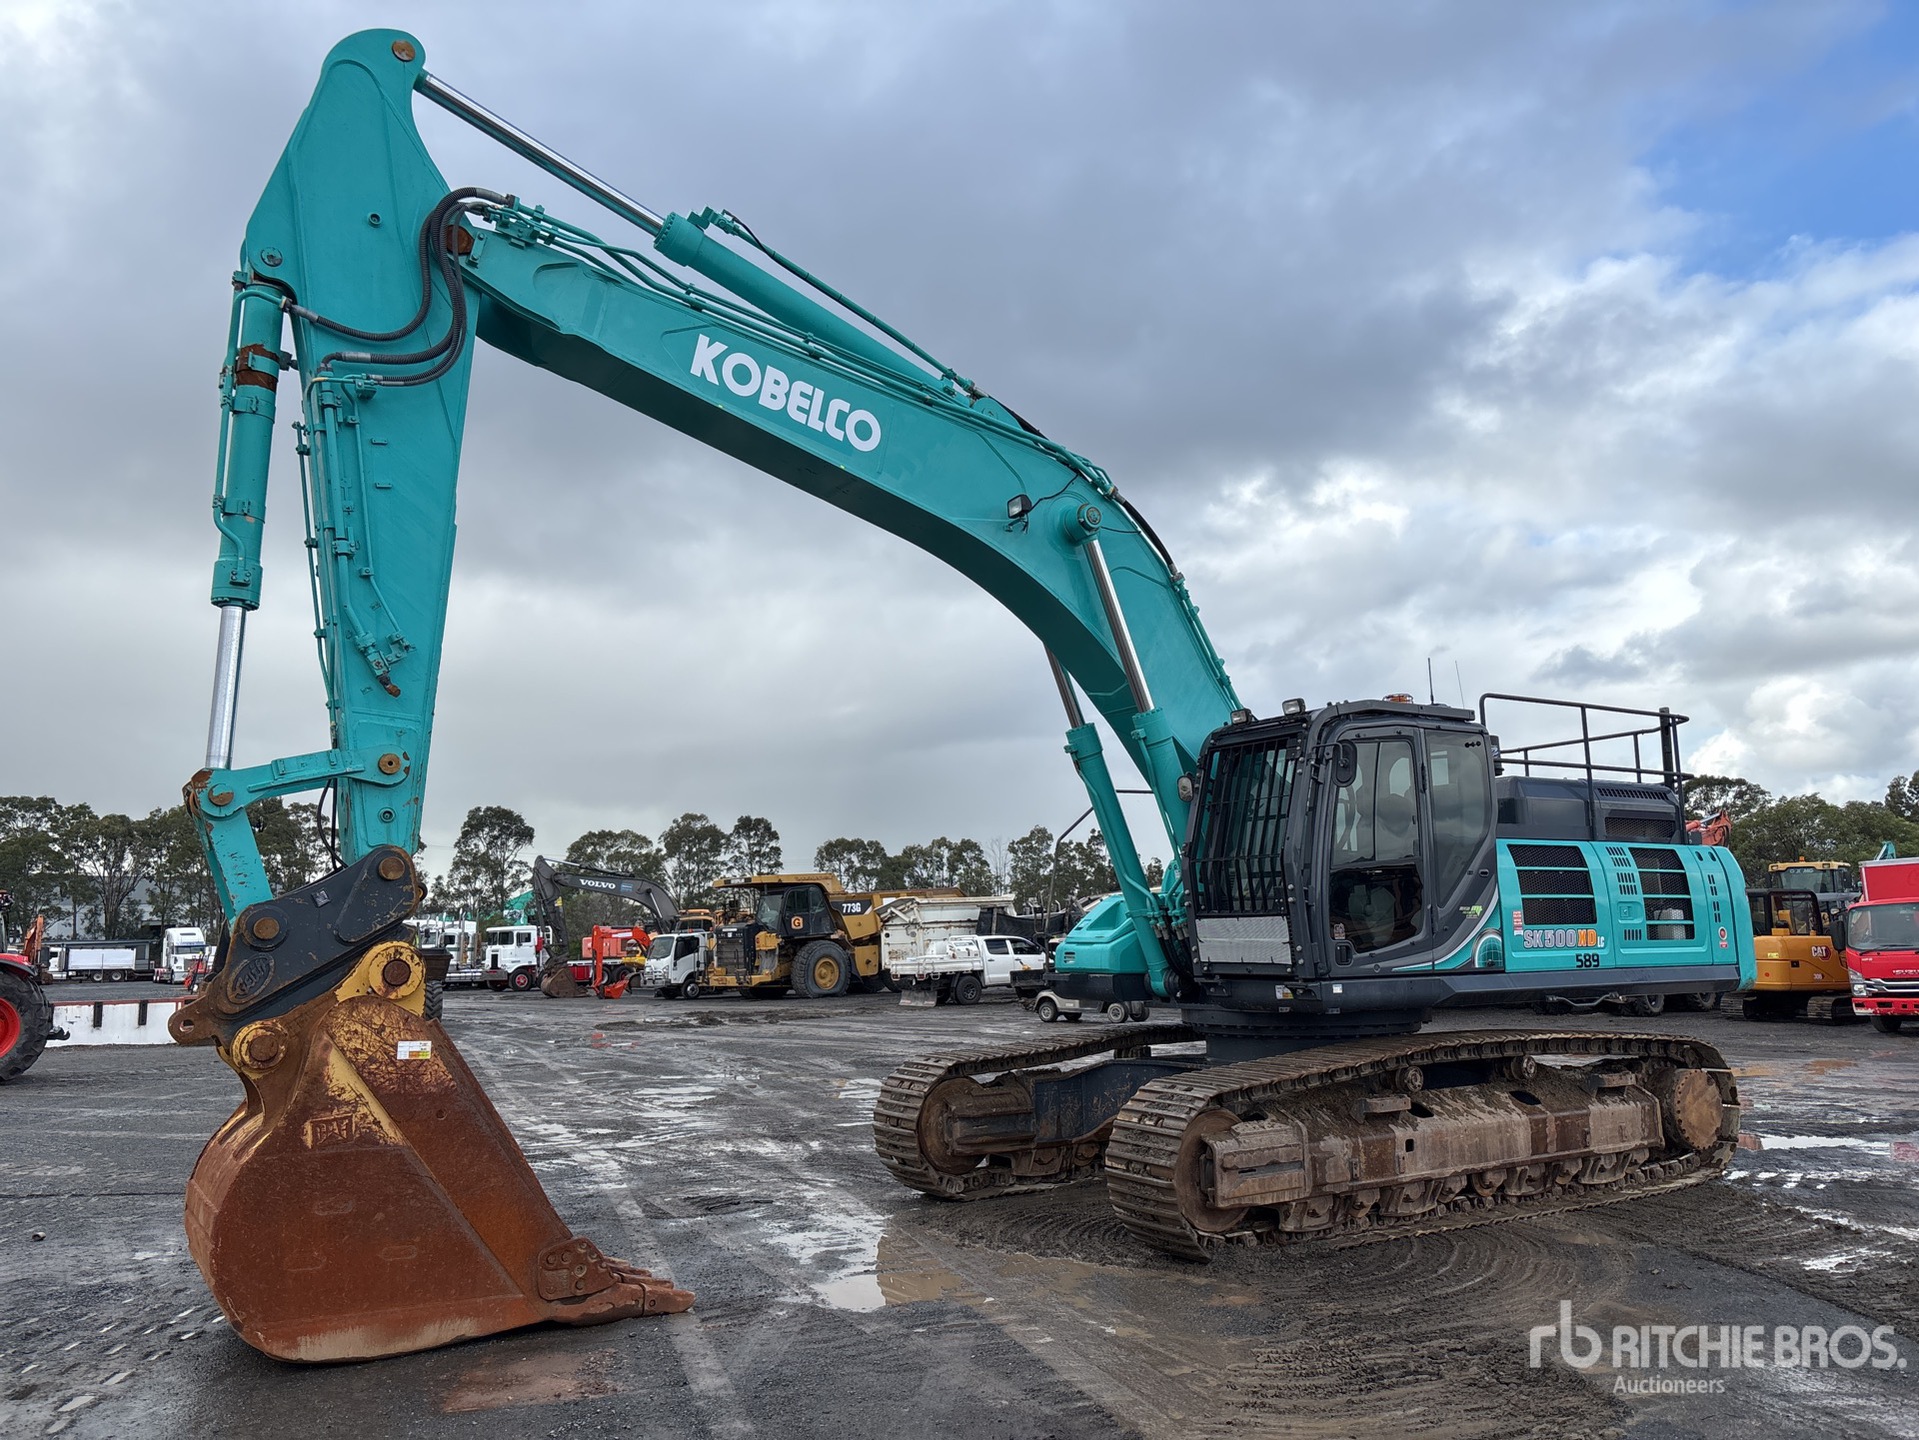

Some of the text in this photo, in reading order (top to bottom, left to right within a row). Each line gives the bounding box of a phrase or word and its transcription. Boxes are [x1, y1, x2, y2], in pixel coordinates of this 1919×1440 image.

[690, 333, 881, 452] KOBELCO
[579, 879, 616, 889] VOLVO
[842, 902, 861, 913] 773G
[1812, 946, 1826, 957] CAT
[1575, 953, 1600, 968] 589
